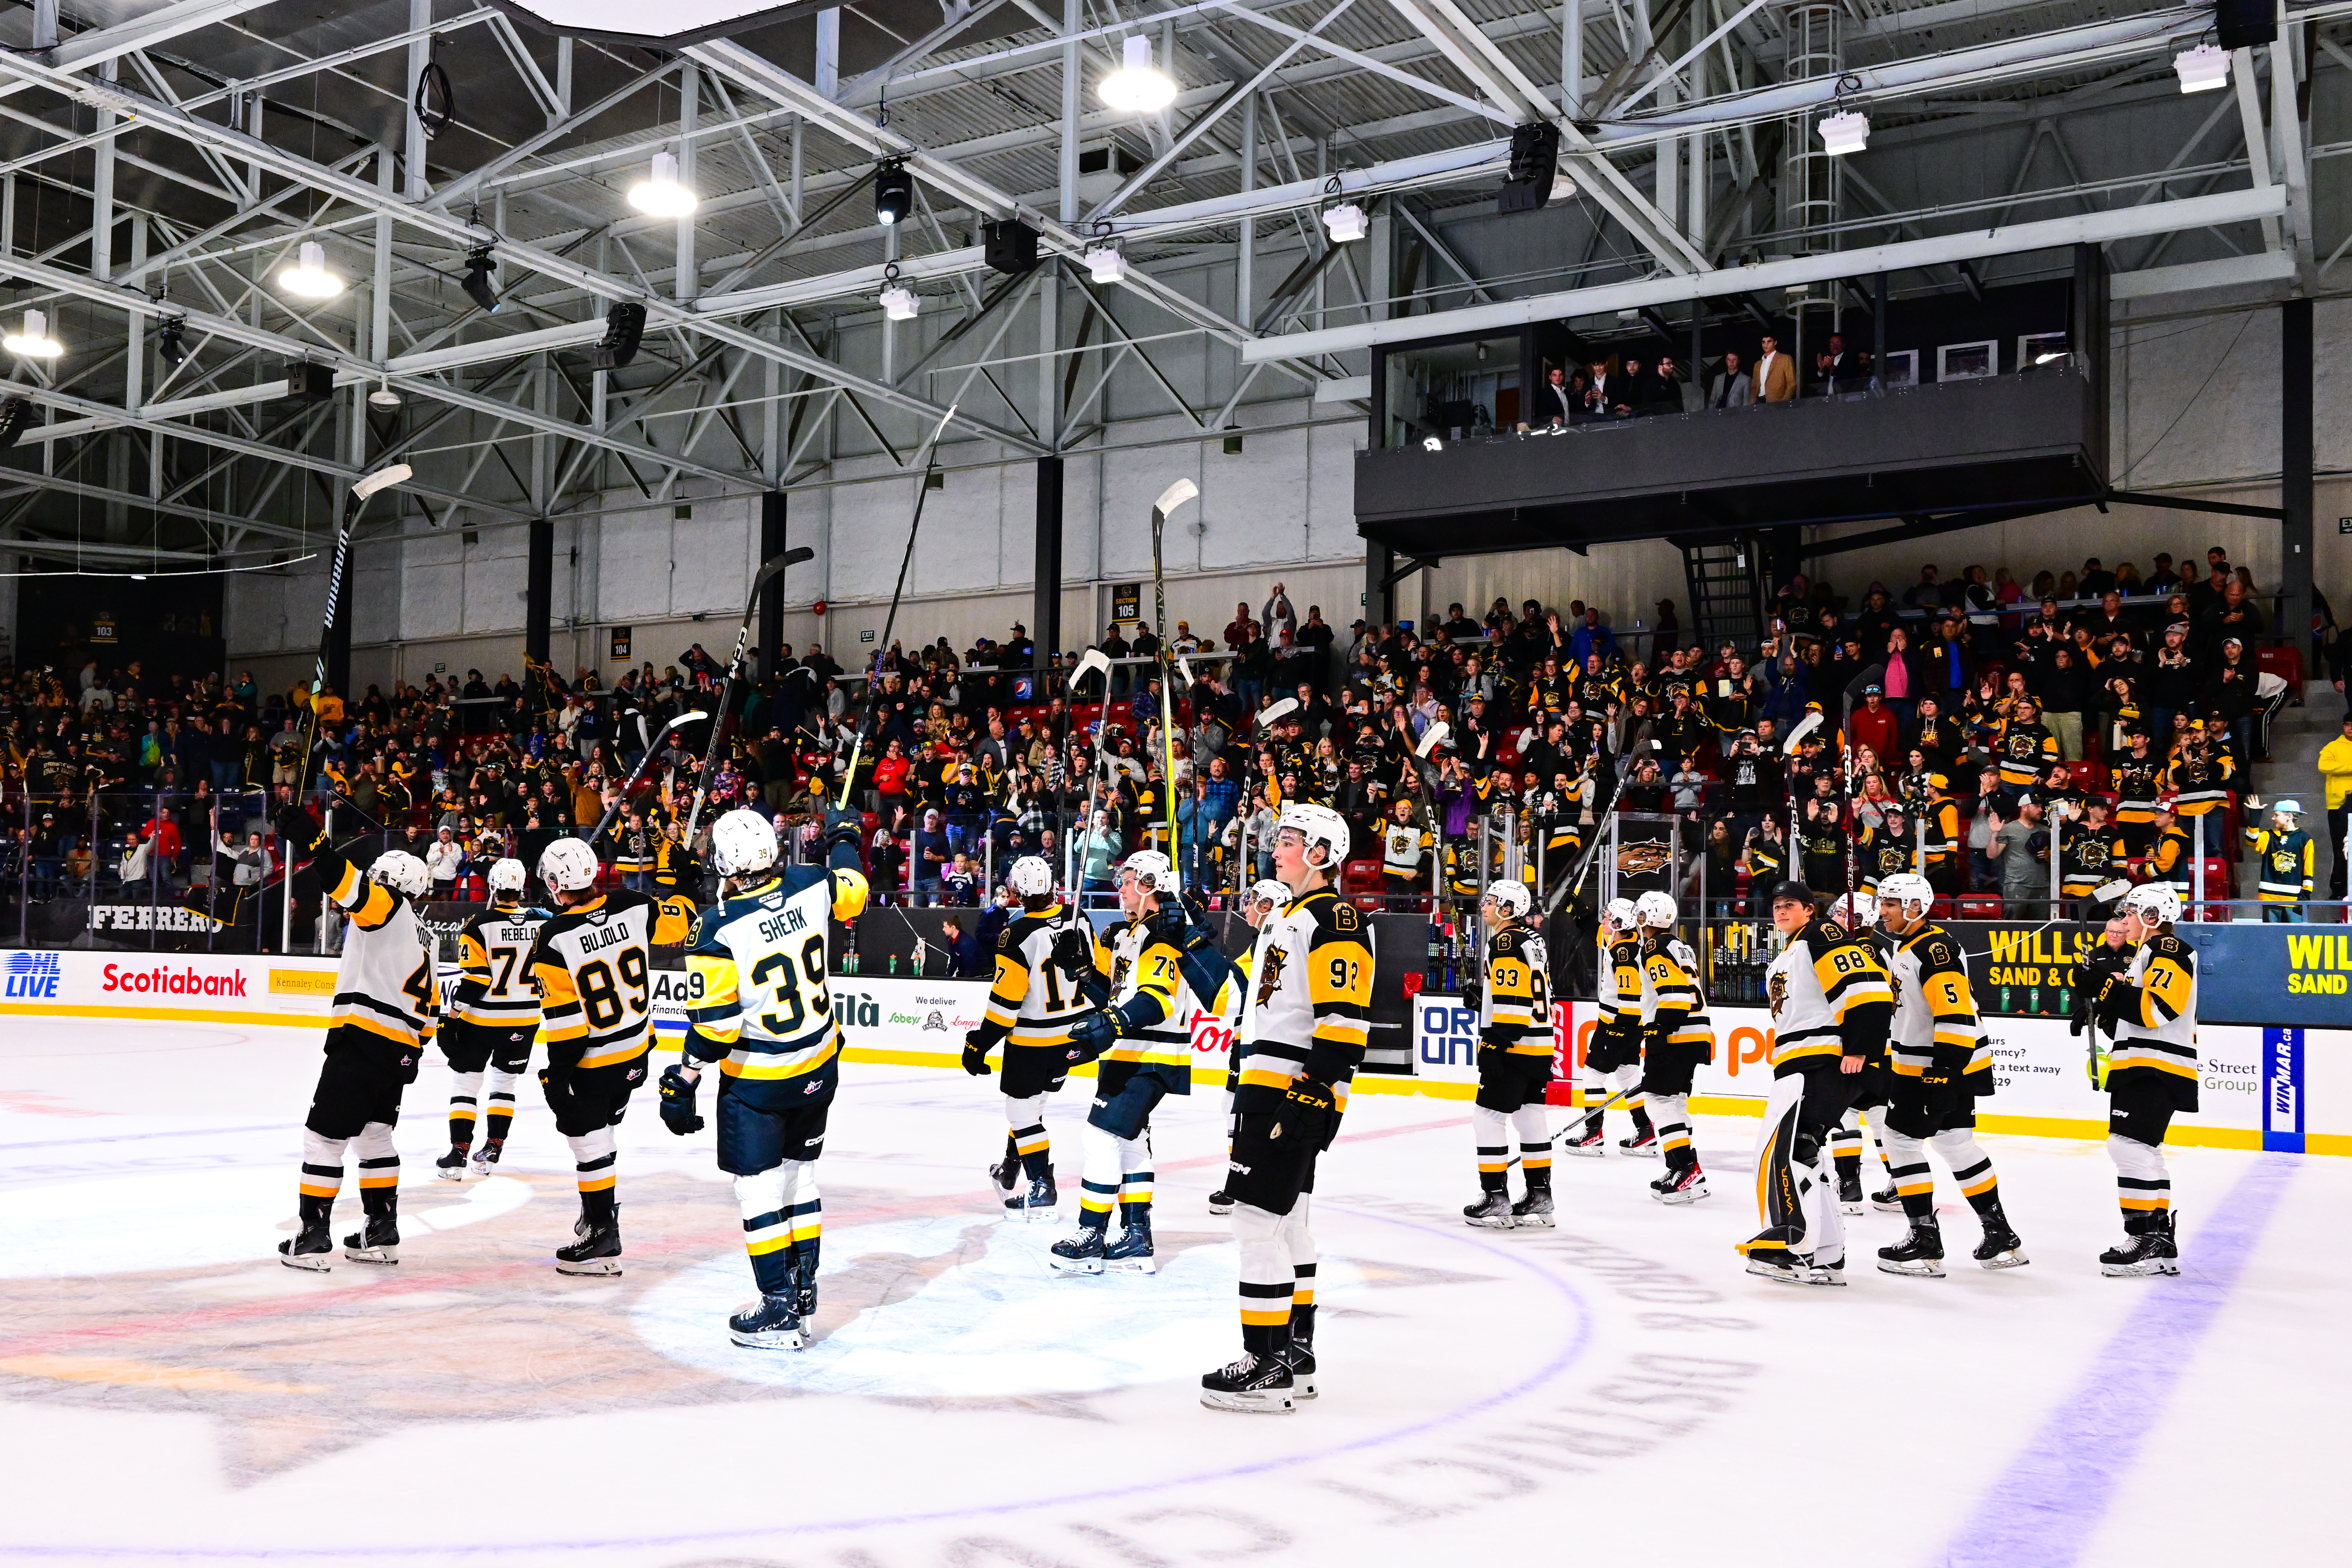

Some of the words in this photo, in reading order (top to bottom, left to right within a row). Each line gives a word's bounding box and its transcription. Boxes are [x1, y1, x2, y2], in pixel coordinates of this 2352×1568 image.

[324, 528, 348, 629] WARRIOR
[1118, 605, 1134, 617] 105
[1156, 578, 1167, 652] VAPOR
[97, 627, 112, 636] 103
[615, 645, 627, 655] 104
[728, 627, 748, 679] CCM
[871, 653, 883, 688] RIBCOR
[705, 713, 724, 767] JETSPEED
[624, 757, 647, 790] CCM
[1239, 775, 1251, 823] CCM
[1426, 805, 1442, 849] CCM
[1790, 795, 1800, 840] CCM
[758, 848, 767, 859] 39
[584, 867, 590, 876] 89
[1227, 866, 1238, 907] RIBCOR
[758, 891, 783, 904] CCM
[586, 909, 606, 918] CCM
[1333, 902, 1358, 931] B
[758, 906, 807, 943] SHERK
[1820, 923, 1843, 942] B
[580, 922, 629, 954] BUJOLD
[1497, 932, 1512, 951] B
[2, 953, 61, 975] OHL
[1616, 947, 1629, 962] B
[1833, 950, 1866, 974] 88
[1928, 942, 1951, 966] B
[491, 946, 539, 997] 74
[992, 965, 1006, 985] 7
[1152, 955, 1175, 982] 78
[1330, 957, 1358, 993] 92
[1495, 968, 1519, 987] 93
[1648, 963, 1670, 982] 68
[1989, 967, 2041, 986] SAND
[2048, 968, 2061, 986] &
[2150, 967, 2174, 990] 71
[5, 976, 60, 997] LIVE
[102, 963, 247, 997] Scotiabank
[276, 977, 311, 990] Kennaley
[401, 949, 433, 1018] 4
[575, 945, 650, 1030] 89
[751, 934, 830, 1036] 39
[1618, 974, 1631, 989] 11
[2098, 978, 2113, 1001] CCM
[2288, 974, 2347, 995] SAND
[916, 996, 928, 1005] We
[930, 996, 956, 1005] deliver
[1943, 983, 1959, 1004] 5
[889, 1013, 921, 1026] Sobeys
[923, 1023, 936, 1031] FARM
[938, 1023, 948, 1032] BOY
[1103, 1007, 1123, 1036] CCM
[1418, 1006, 1481, 1036] OR
[1416, 1037, 1481, 1066] UN
[2008, 1064, 2030, 1072] text
[2034, 1066, 2061, 1075] away
[2209, 1059, 2257, 1074] Street
[2204, 1078, 2257, 1095] Group
[1286, 1090, 1328, 1109] CCM
[1579, 1135, 1600, 1147] CCM
[1677, 1171, 1699, 1191] CCM
[1781, 1164, 1793, 1215] VAPOR
[575, 1245, 594, 1257] BAUER
[757, 1316, 788, 1332] CCM
[1254, 1371, 1284, 1390] CCM
